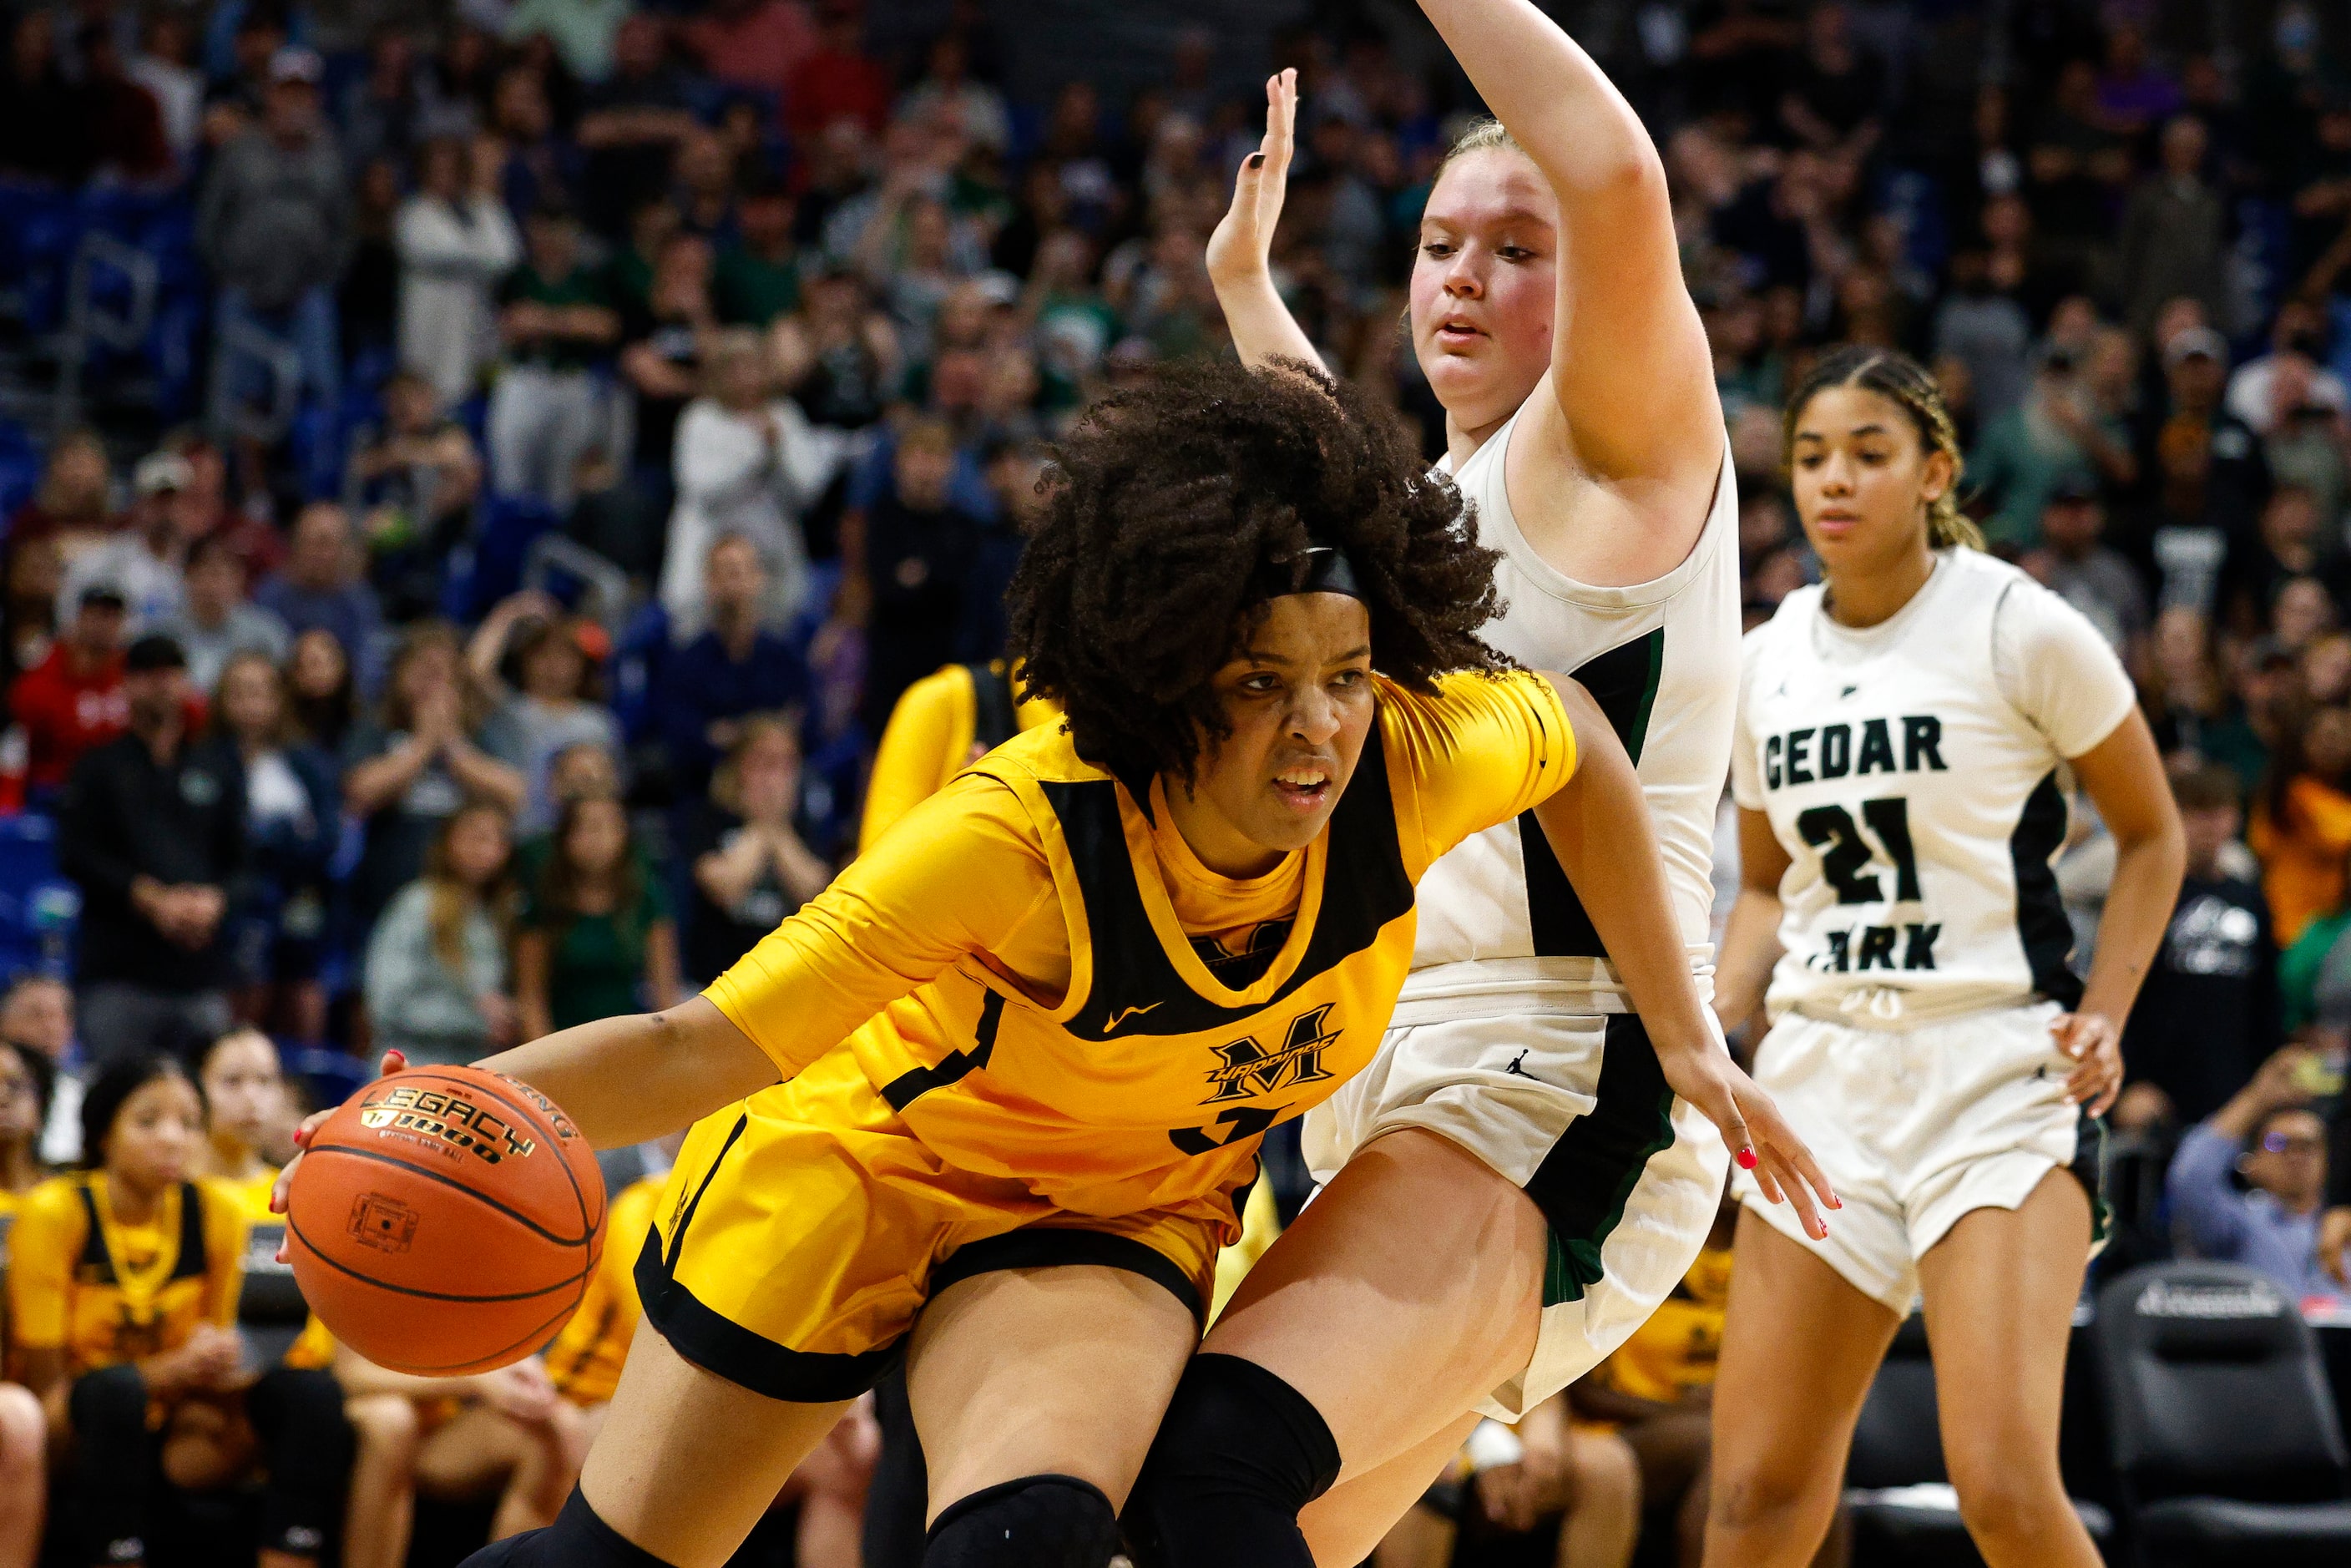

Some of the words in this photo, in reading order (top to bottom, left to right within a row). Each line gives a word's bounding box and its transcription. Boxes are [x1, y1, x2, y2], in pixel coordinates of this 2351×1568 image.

[1767, 716, 1949, 790] CEDAR
[1797, 797, 1922, 903] 21
[1196, 1002, 1337, 1105] M
[360, 1087, 536, 1157] LEGACY
[395, 1112, 503, 1165] 1000
